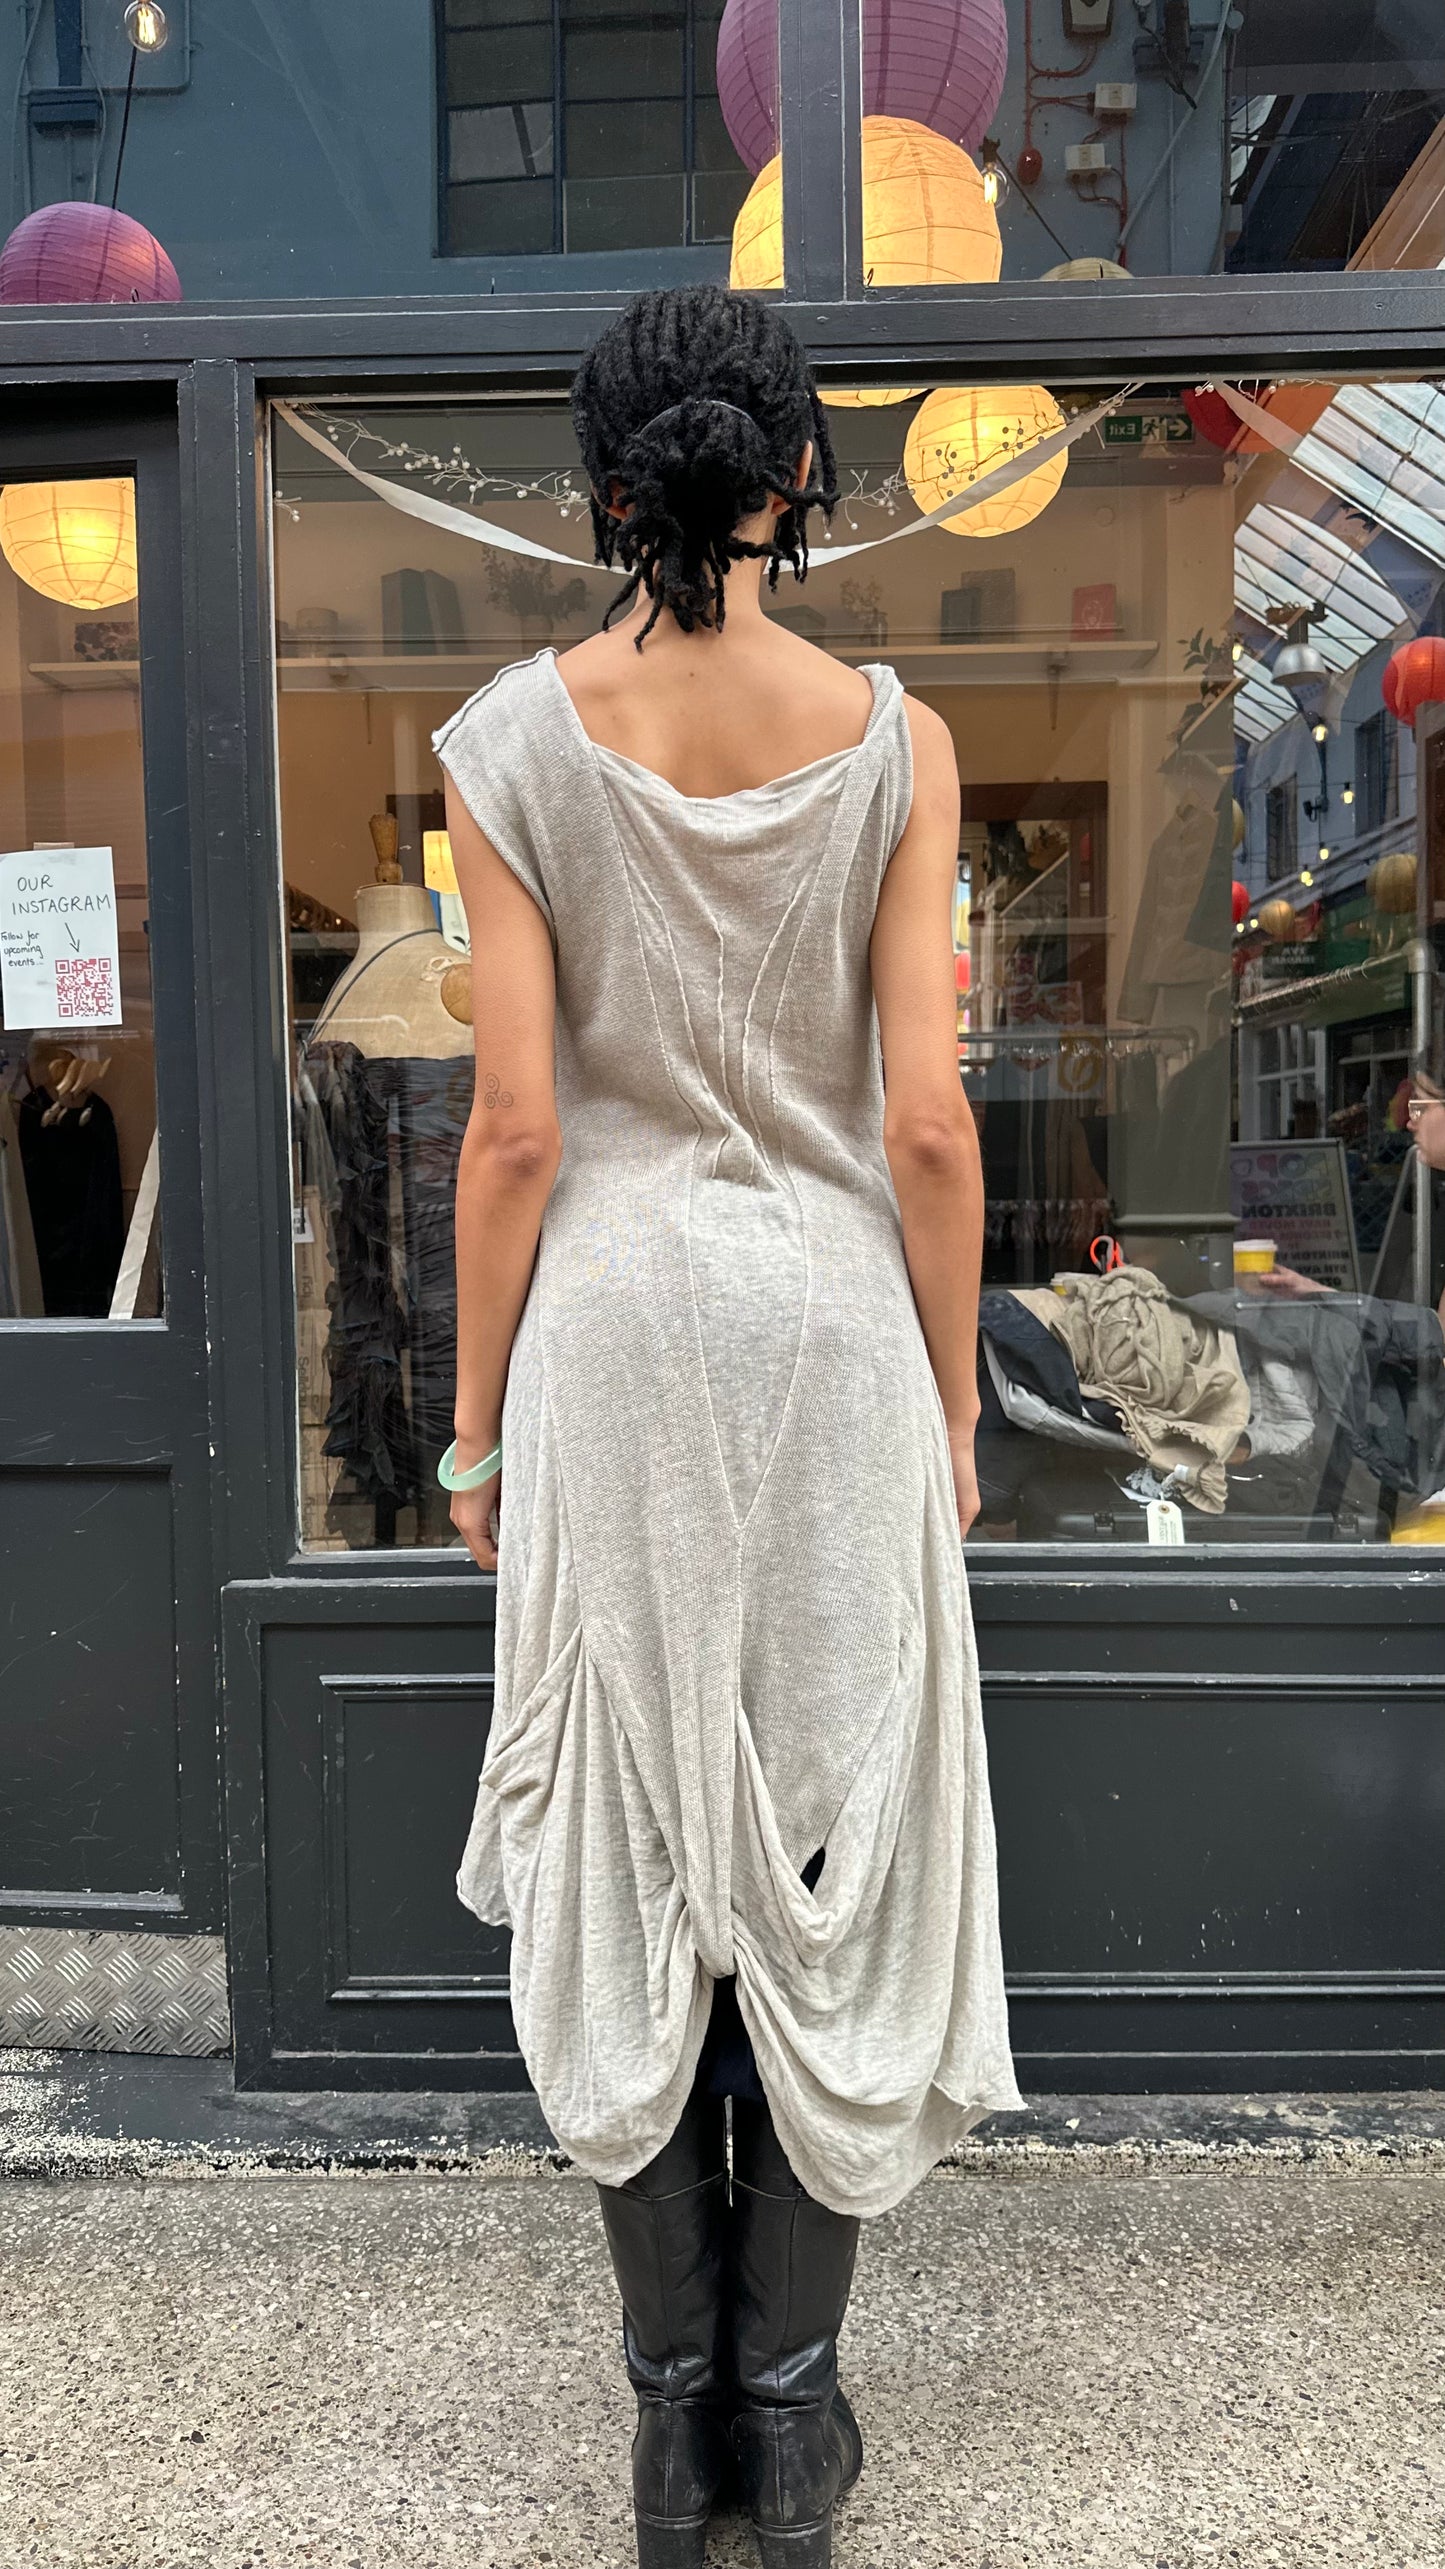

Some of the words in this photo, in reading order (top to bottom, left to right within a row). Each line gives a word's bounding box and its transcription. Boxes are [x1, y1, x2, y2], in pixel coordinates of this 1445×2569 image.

[17, 874, 54, 892] OUR
[12, 893, 112, 915] INSTAGRAM
[0, 931, 23, 941] Follow
[26, 930, 40, 946] for
[4, 945, 44, 959] upcoming
